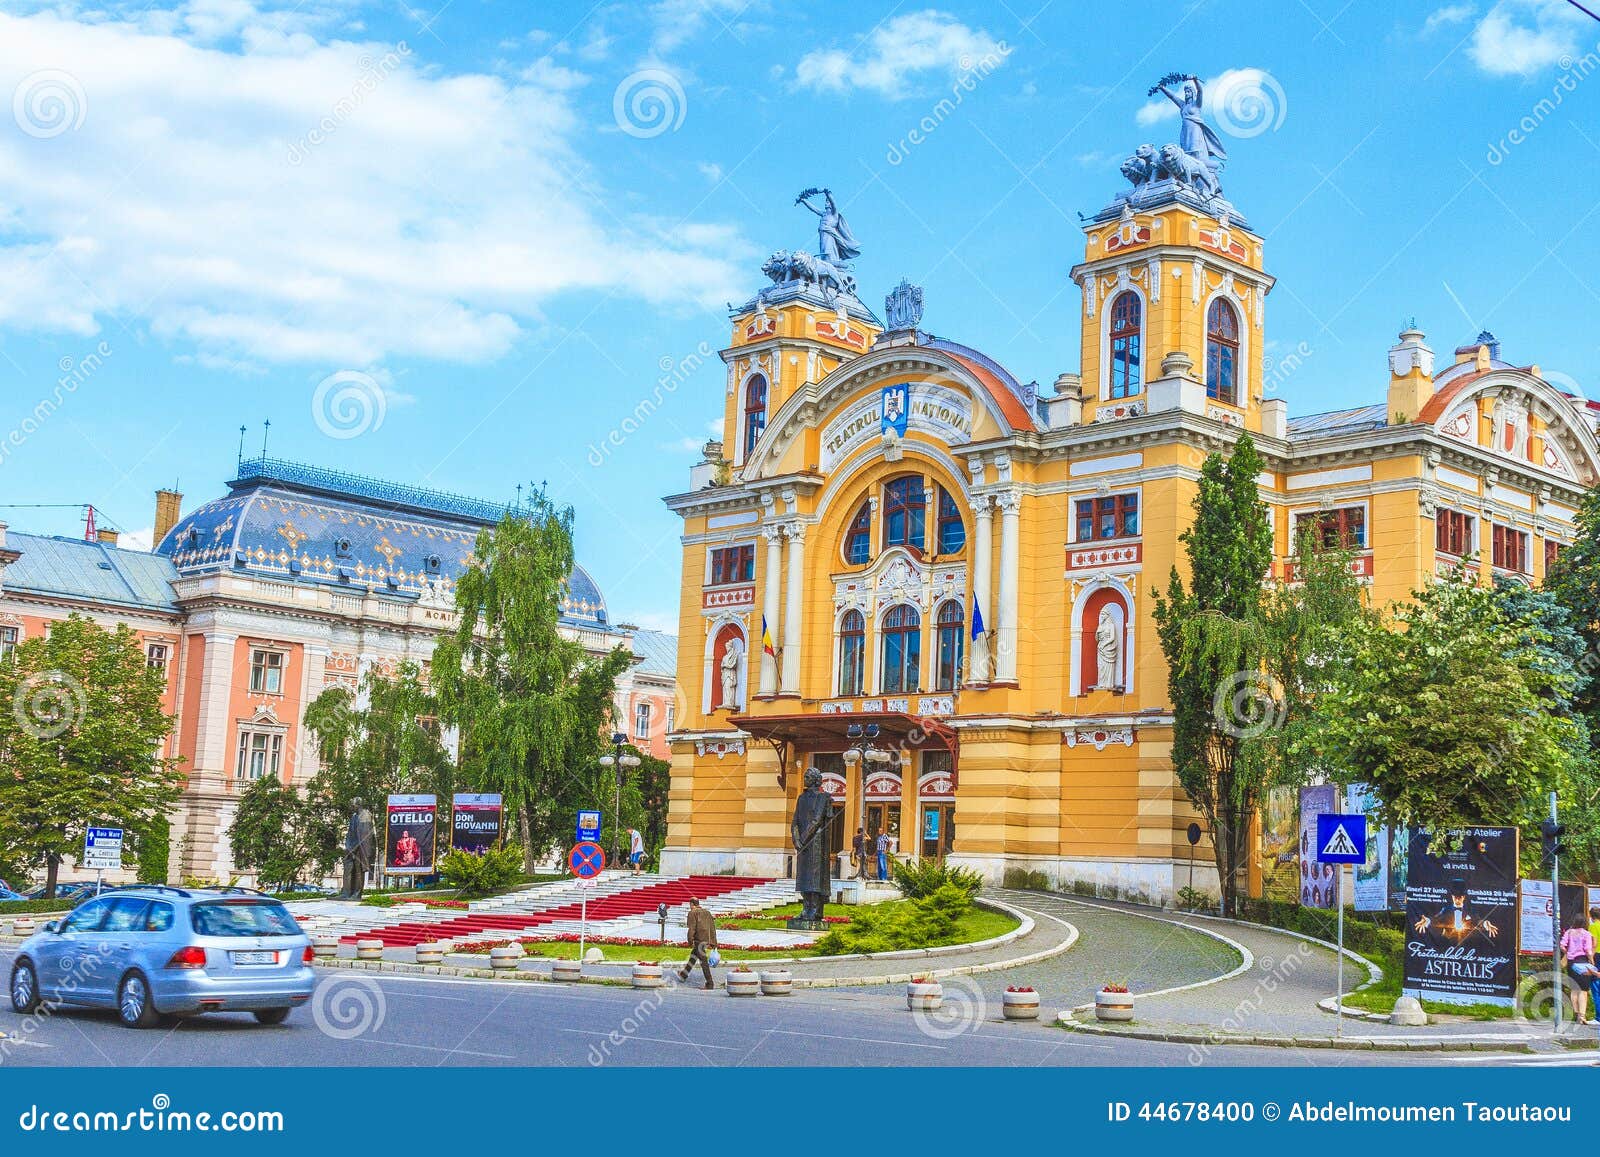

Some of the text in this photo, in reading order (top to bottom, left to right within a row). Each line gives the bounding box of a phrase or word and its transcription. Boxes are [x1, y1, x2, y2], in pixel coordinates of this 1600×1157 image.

[827, 409, 880, 455] TEATRUL
[390, 813, 433, 823] OTELLO
[455, 814, 473, 822] DON
[455, 821, 498, 830] GIOVANNI
[1473, 828, 1502, 837] Atelier
[1463, 948, 1476, 960] de
[1424, 959, 1494, 980] ASTRALIS
